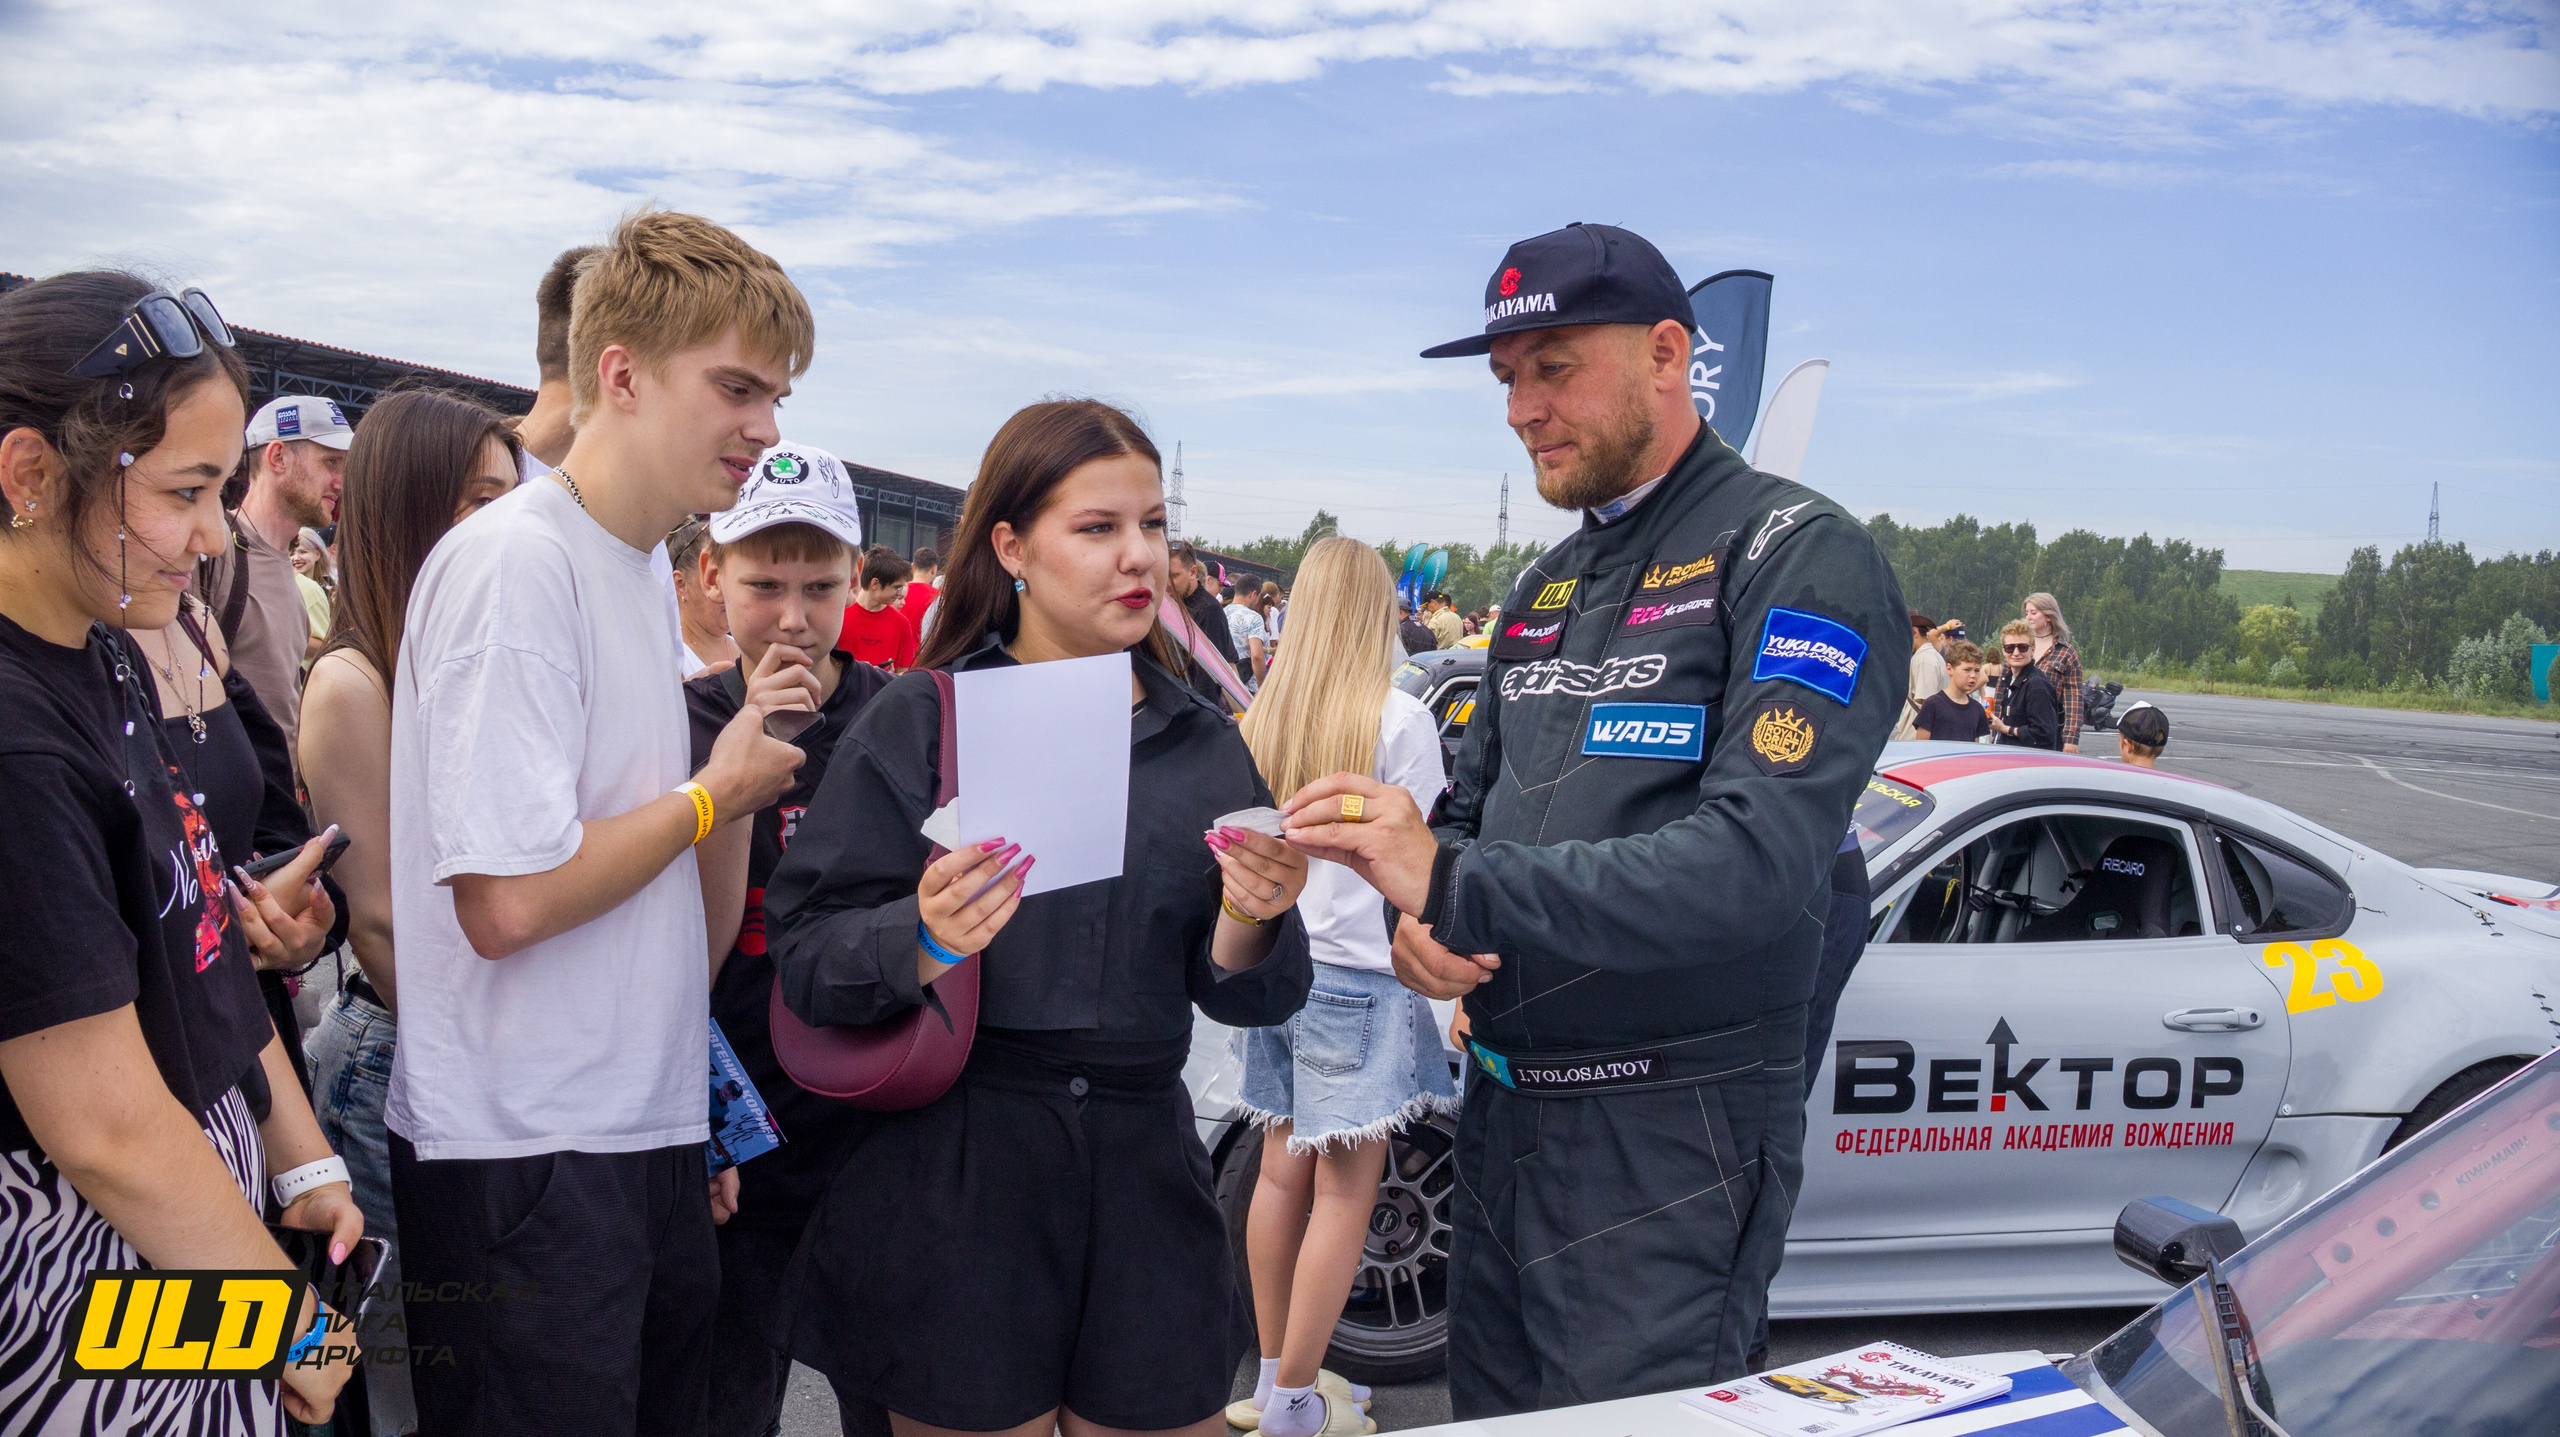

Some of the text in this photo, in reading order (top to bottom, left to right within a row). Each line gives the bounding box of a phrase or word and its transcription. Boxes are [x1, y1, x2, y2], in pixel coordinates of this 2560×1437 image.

[1485, 293, 1557, 325] AKAYAMA
[1669, 554, 1715, 579] ROYAL
[1538, 581, 1573, 607] ULD
[1767, 634, 1858, 673] YUKA DRIVE
[1592, 720, 1696, 745] WADS
[1762, 731, 1800, 751] DRIFT
[1765, 724, 1800, 741] ROYAL
[1765, 742, 1791, 756] SERIES
[2101, 857, 2146, 877] RECARO
[2262, 938, 2384, 1015] 23
[1517, 1059, 1653, 1084] I.VOLOSATOV
[742, 1088, 780, 1145] КОРНЕВ
[1835, 1121, 2235, 1157] ФЕДЕРАЛЬНАЯ АКАДЕМИЯ ВОЖДЕНИЯ
[2456, 1134, 2530, 1188] KIWAMARU
[1887, 1360, 1976, 1390] TAKAYAMA
[1286, 1398, 1310, 1412] NIKE
